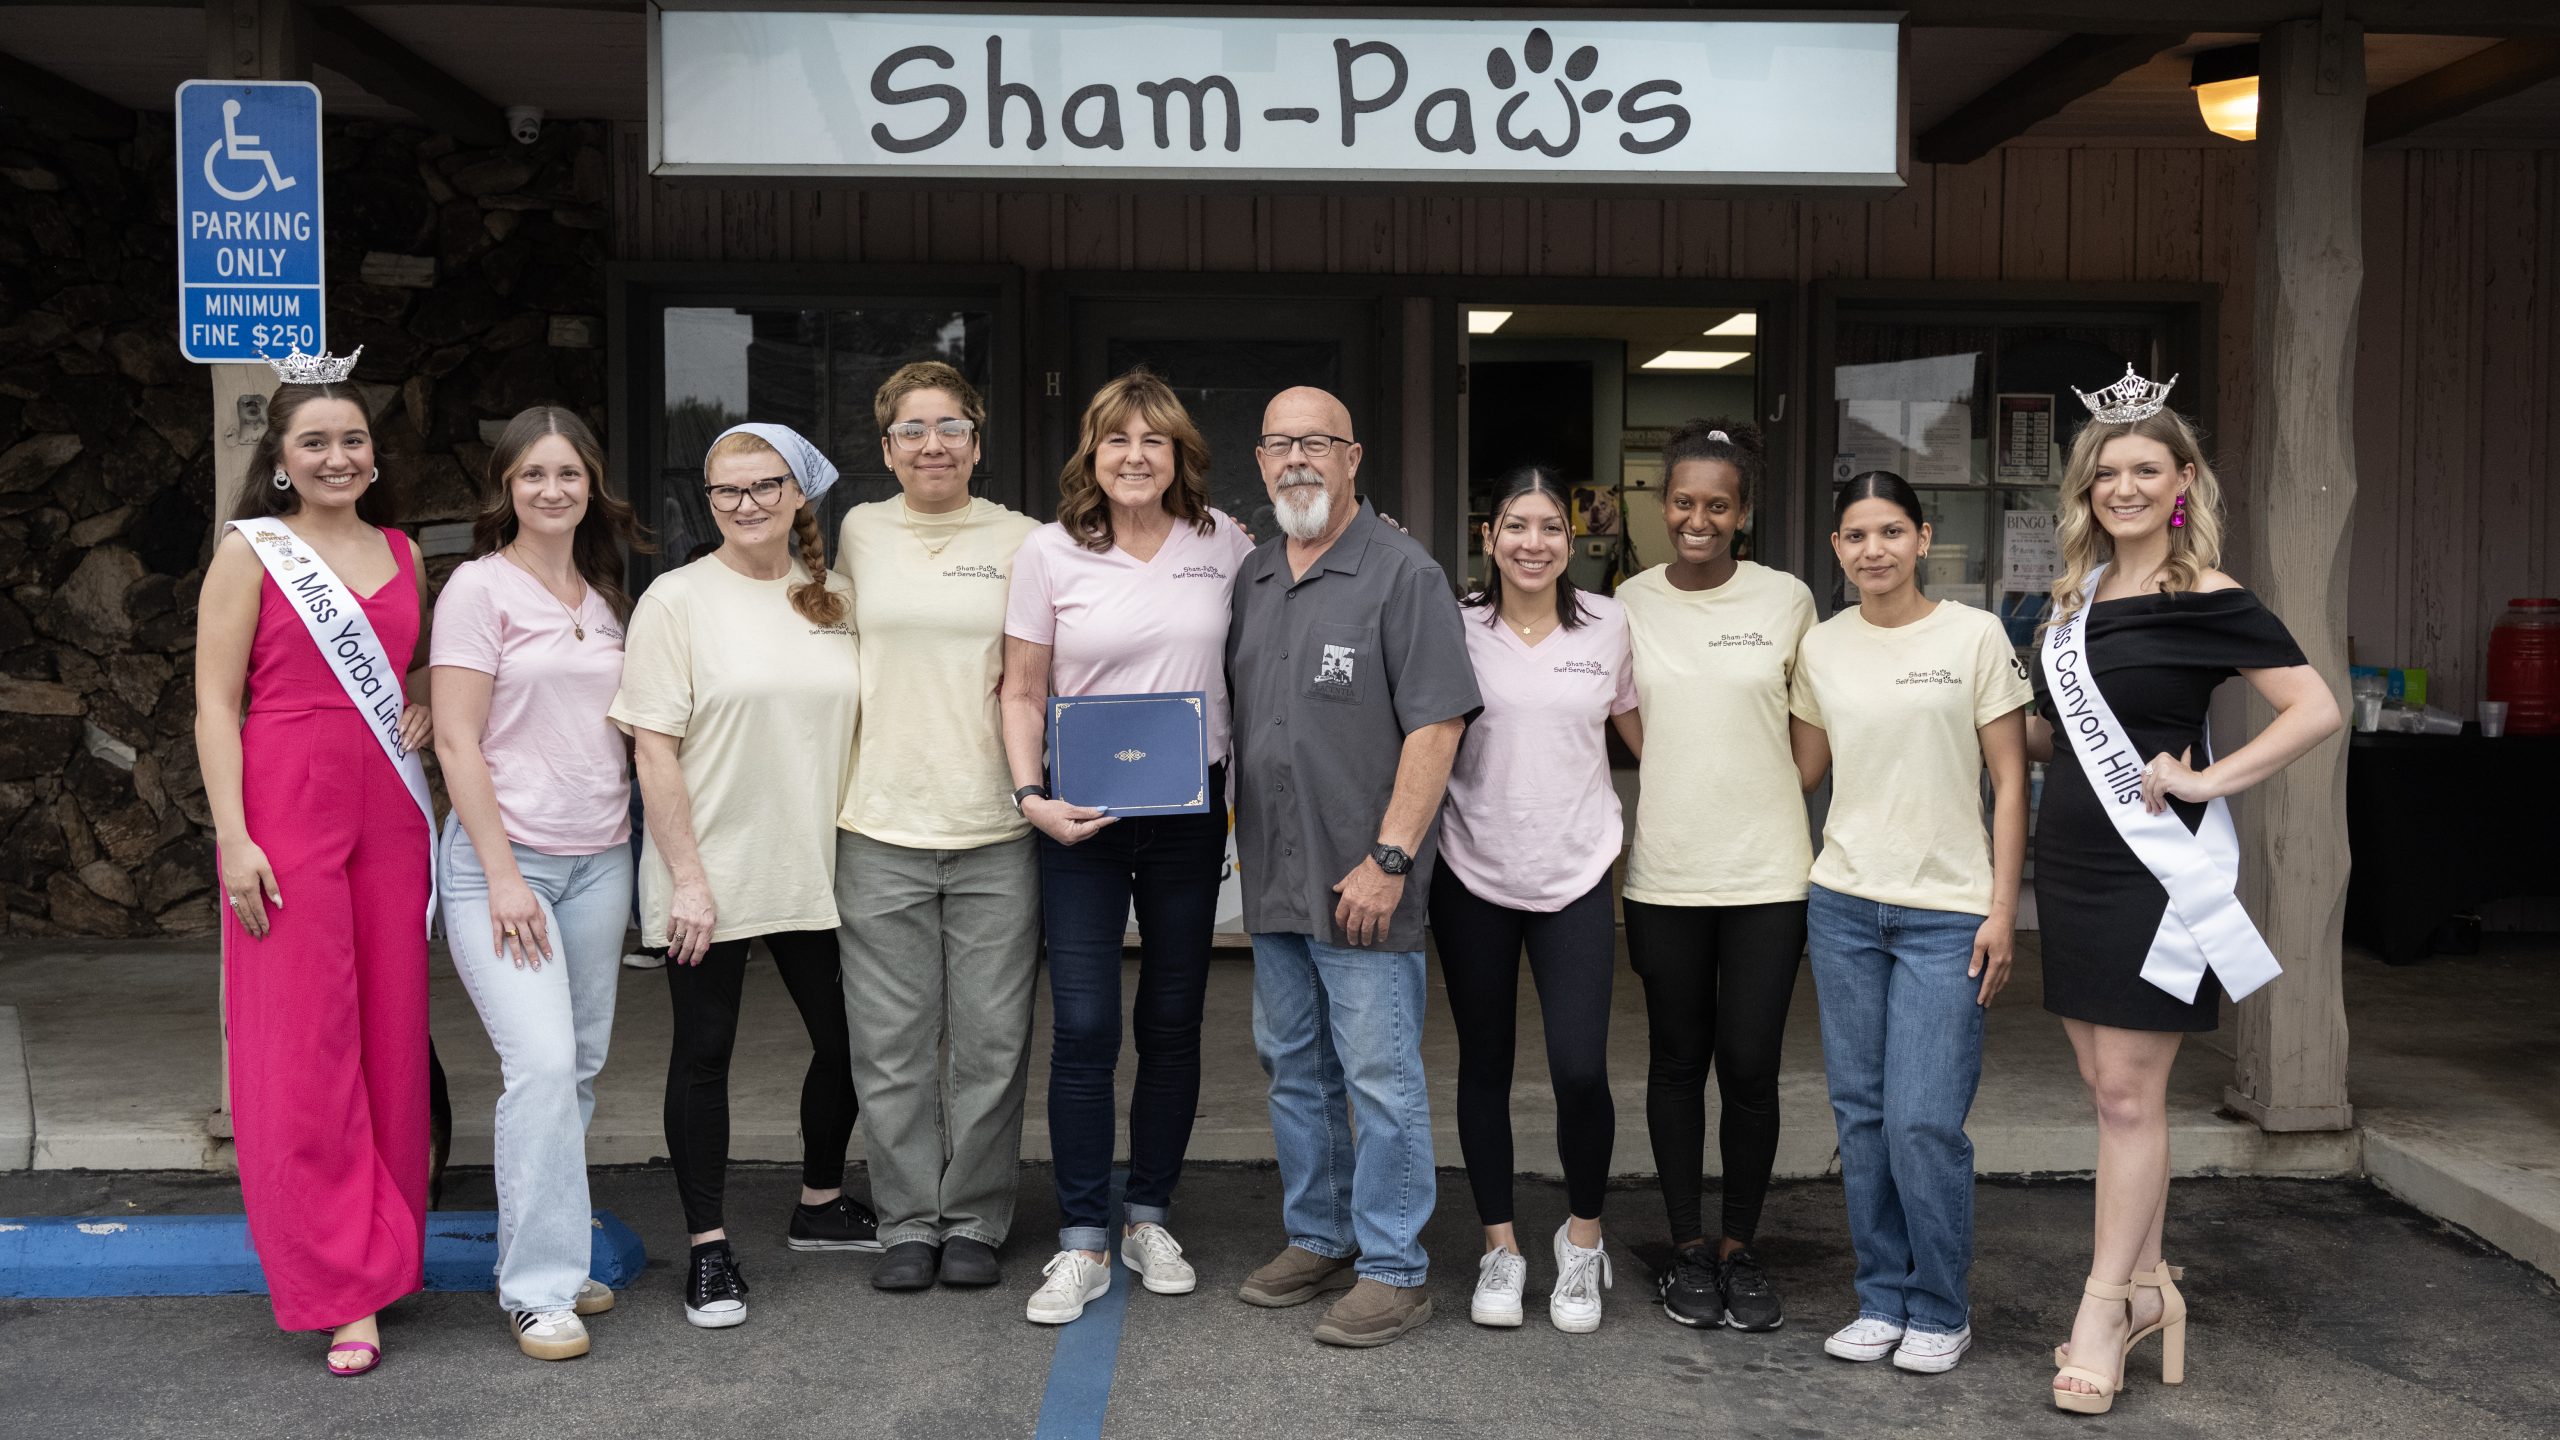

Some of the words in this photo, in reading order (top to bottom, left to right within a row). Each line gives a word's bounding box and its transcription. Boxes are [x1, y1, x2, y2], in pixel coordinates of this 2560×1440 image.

[870, 27, 1692, 157] Sham-Paws
[191, 211, 311, 241] PARKING
[216, 247, 286, 277] ONLY
[205, 294, 300, 317] MINIMUM
[192, 324, 240, 346] FINE
[252, 322, 314, 347] $250
[1045, 371, 1061, 396] H
[1769, 393, 1786, 422] J
[2007, 516, 2046, 529] BINGO
[291, 571, 338, 624] Miss
[330, 619, 382, 699] Yorba
[373, 693, 406, 762] Linda
[2055, 650, 2108, 752] Canyon
[2097, 750, 2142, 805] Hills
